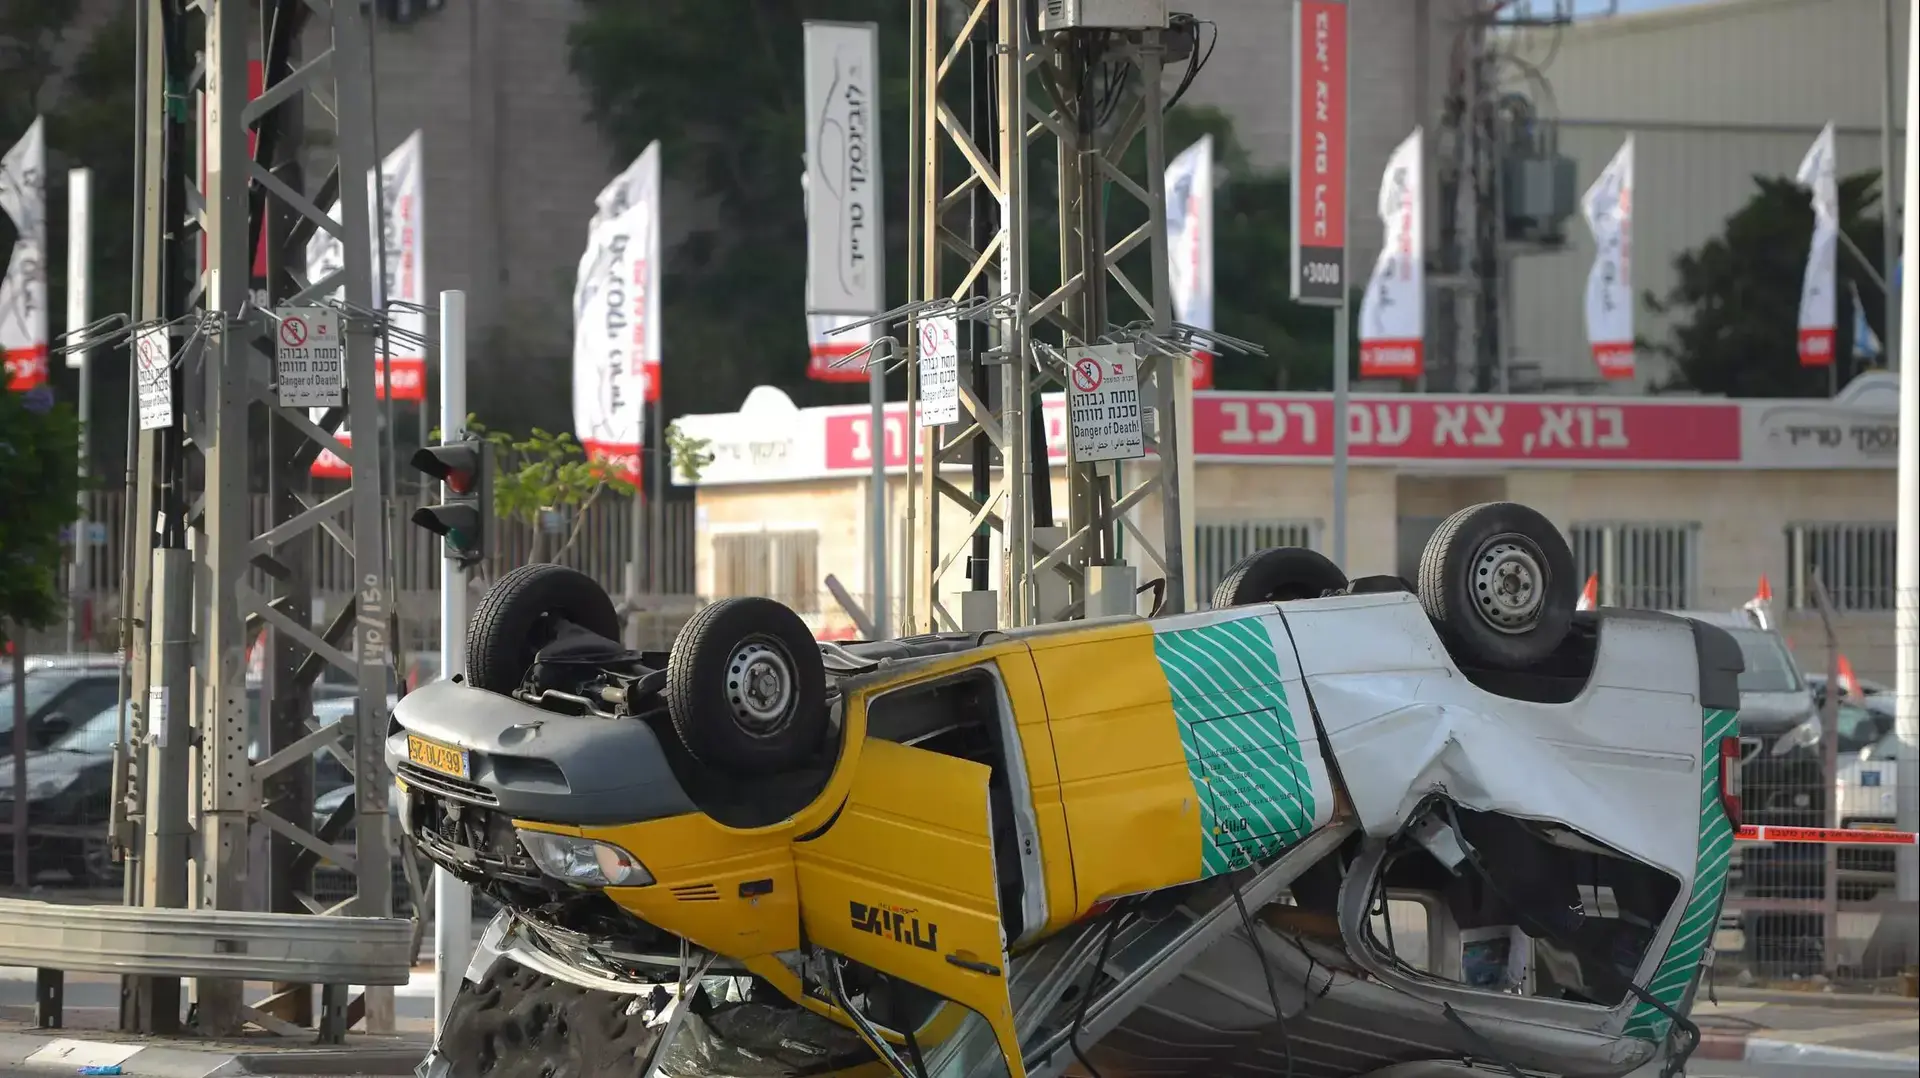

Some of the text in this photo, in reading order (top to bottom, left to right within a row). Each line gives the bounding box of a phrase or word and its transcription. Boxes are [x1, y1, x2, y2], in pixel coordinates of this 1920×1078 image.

[1072, 389, 1137, 408] מתח גבוה!
[1072, 408, 1104, 423] מוות!
[1108, 404, 1137, 419] סכנת
[1074, 420, 1140, 440] Danger of Death!
[1219, 401, 1630, 456] בוא, צא עם רכב
